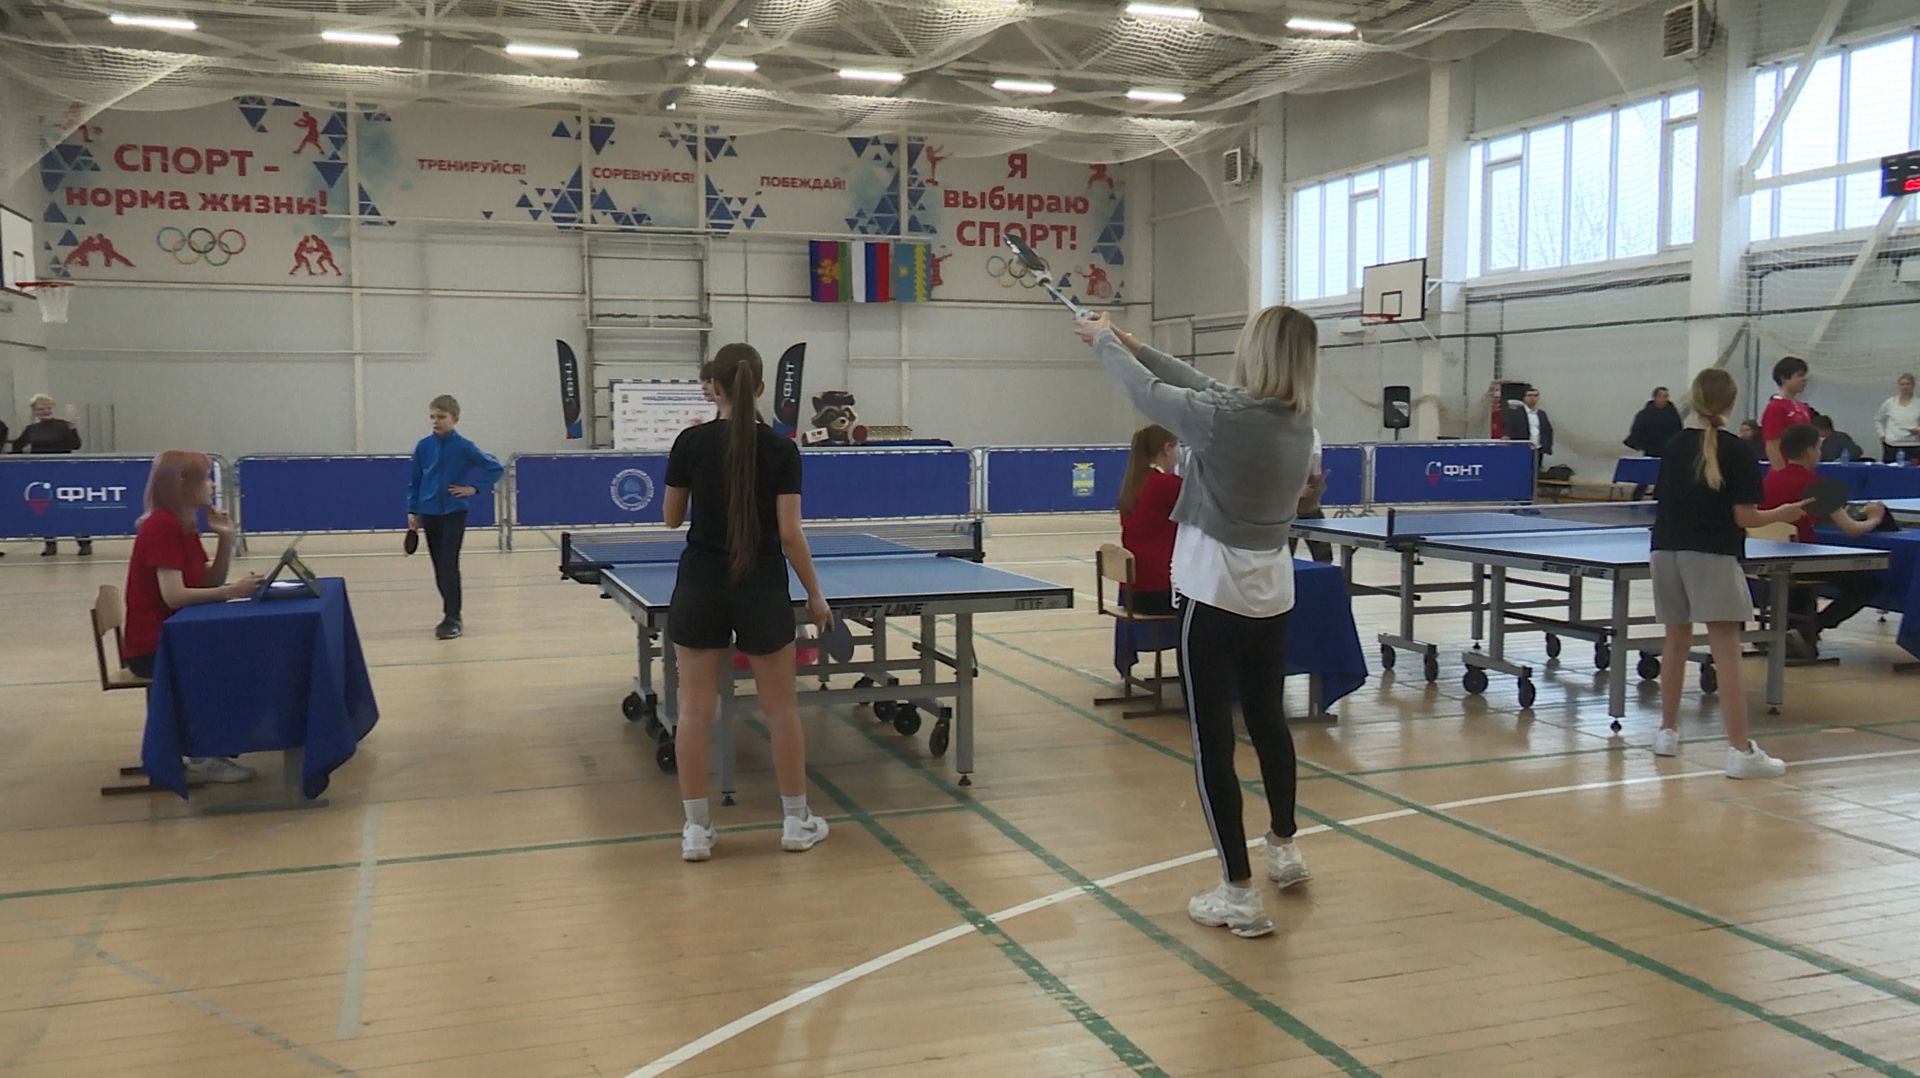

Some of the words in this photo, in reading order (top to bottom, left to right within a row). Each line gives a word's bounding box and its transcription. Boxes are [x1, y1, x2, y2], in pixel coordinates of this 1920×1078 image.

[113, 143, 254, 177] СПОРТ
[416, 158, 526, 175] ТРЕНИРУЙСЯ!
[1007, 153, 1028, 179] Я
[591, 167, 695, 184] СОРЕВНУЙСЯ!
[760, 175, 846, 191] ПОБЕЖДАЙ!
[64, 186, 190, 216] норма
[198, 189, 329, 215] жизни!
[943, 185, 1090, 219] выбираю
[955, 219, 1078, 251] СПОРТ!
[1443, 464, 1484, 477] ФНТ
[55, 486, 128, 502] ФНТ
